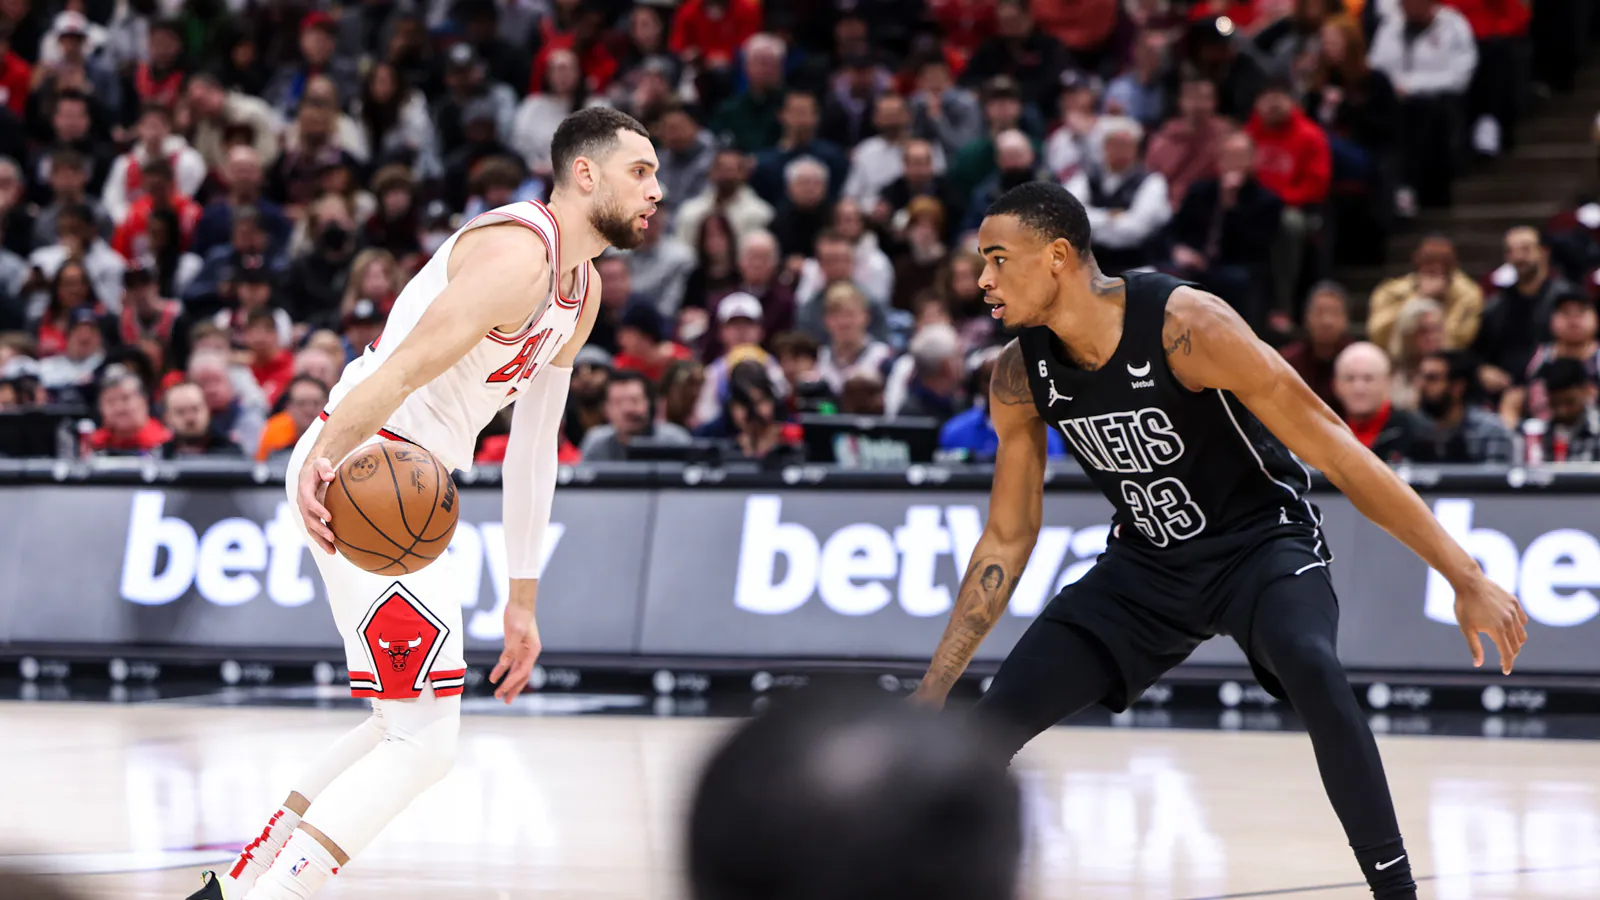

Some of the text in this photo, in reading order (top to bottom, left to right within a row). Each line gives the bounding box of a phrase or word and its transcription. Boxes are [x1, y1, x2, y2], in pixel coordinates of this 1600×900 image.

[1038, 359, 1048, 378] 6
[1131, 379, 1155, 389] Webull
[1058, 407, 1185, 473] NETS
[1120, 476, 1206, 547] 33
[120, 490, 566, 640] betay
[1424, 497, 1600, 627] be
